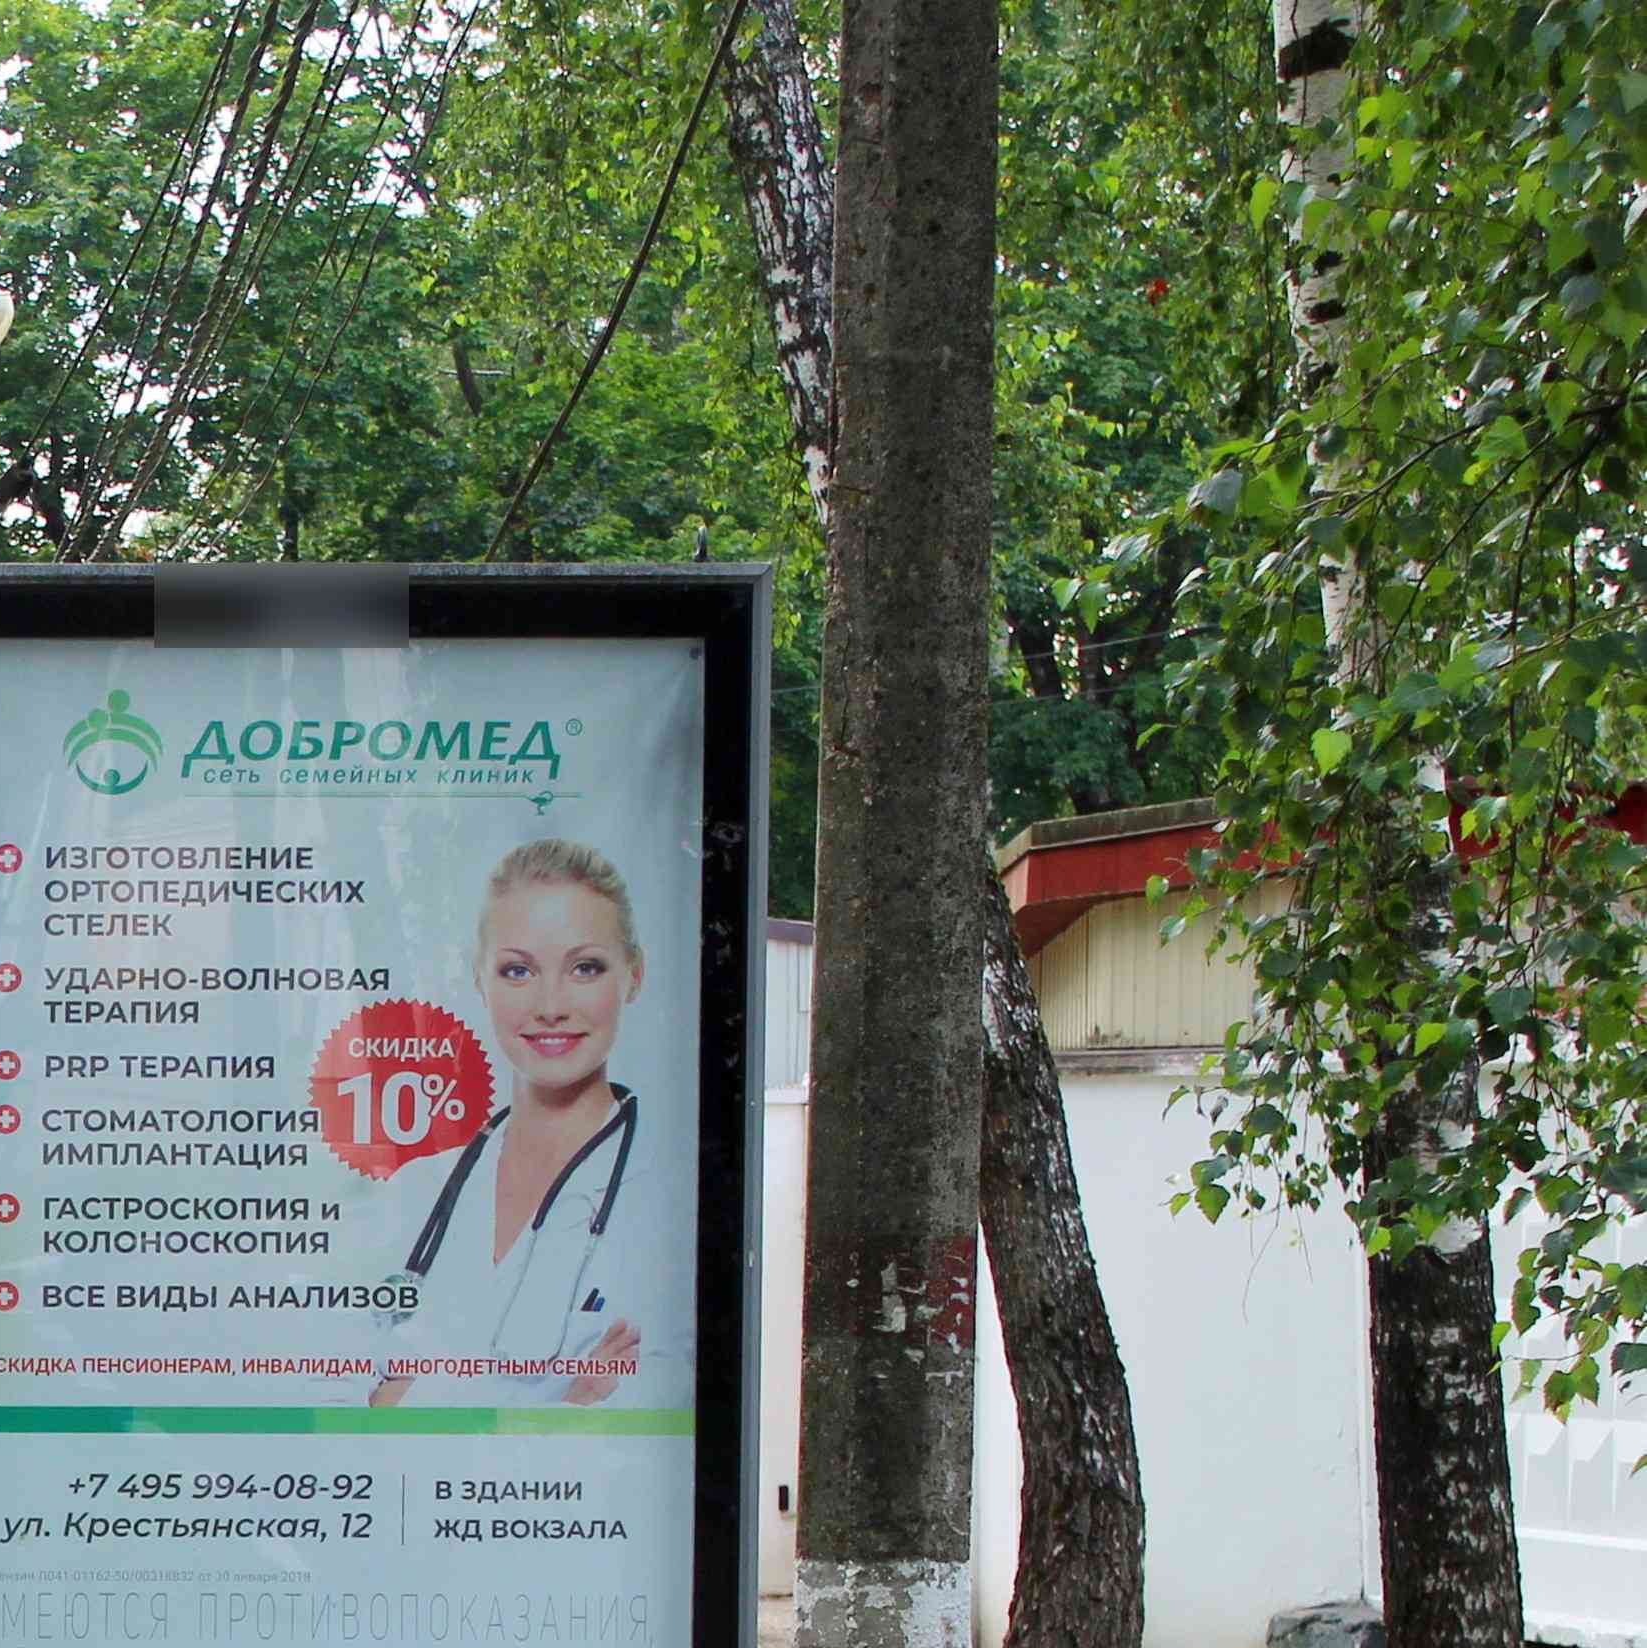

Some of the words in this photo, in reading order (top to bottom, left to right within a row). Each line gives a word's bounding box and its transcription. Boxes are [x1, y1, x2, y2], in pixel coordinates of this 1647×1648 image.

[179, 719, 562, 779] ДОБРОМЕД
[203, 769, 261, 785] сеть
[279, 765, 417, 785] семейных
[437, 768, 535, 785] клиник
[45, 846, 314, 870] ИЗГОТОВЛЕНИЕ
[44, 880, 366, 907] ОРТОПЕДИЧЕСКИХ
[44, 913, 173, 937] СТЕЛЕК
[44, 968, 391, 994] УДАРНО-ВОЛНОВАЯ
[43, 1001, 200, 1024] ТЕРАПИЯ
[348, 1037, 456, 1063] СКИДКА
[44, 1055, 110, 1078] PRP
[120, 1055, 275, 1079] ТЕРАПИЯ
[337, 1070, 466, 1145] 10%
[41, 1109, 320, 1133] СТОМАТОЛОГИЯ
[41, 1143, 308, 1170] ИМПЛАНТАЦИЯ
[43, 1197, 309, 1221] ГАСТРОСКОПИЯ
[321, 1203, 341, 1221] и
[43, 1231, 330, 1254] КОЛОНОСКОПИЯ
[41, 1285, 105, 1308] ВСЕ
[116, 1285, 217, 1312] ВИДЫ
[228, 1285, 420, 1309] АНАЛИЗОВ
[82, 1357, 236, 1377] ПЕНСИОНЕРАМ,
[242, 1358, 377, 1377] ИНВАЛИДАМ,
[388, 1358, 547, 1377] МНОГОДЕТНЫМ
[552, 1359, 637, 1376] СЕМЬЯМ
[68, 1473, 110, 1499] +7
[117, 1473, 183, 1499] 495
[192, 1473, 373, 1500] 994-08-92
[435, 1481, 453, 1500] В
[461, 1480, 583, 1504] ЗДАНИИ
[0, 1517, 51, 1544] ул.
[63, 1512, 327, 1544] Крестьянская,
[340, 1513, 373, 1539] 12
[434, 1519, 483, 1543] ЖД
[491, 1519, 628, 1540] ВОКЗАЛА
[200, 1592, 654, 1647] ПРОТИВОПОКАЗАНИЯ,
